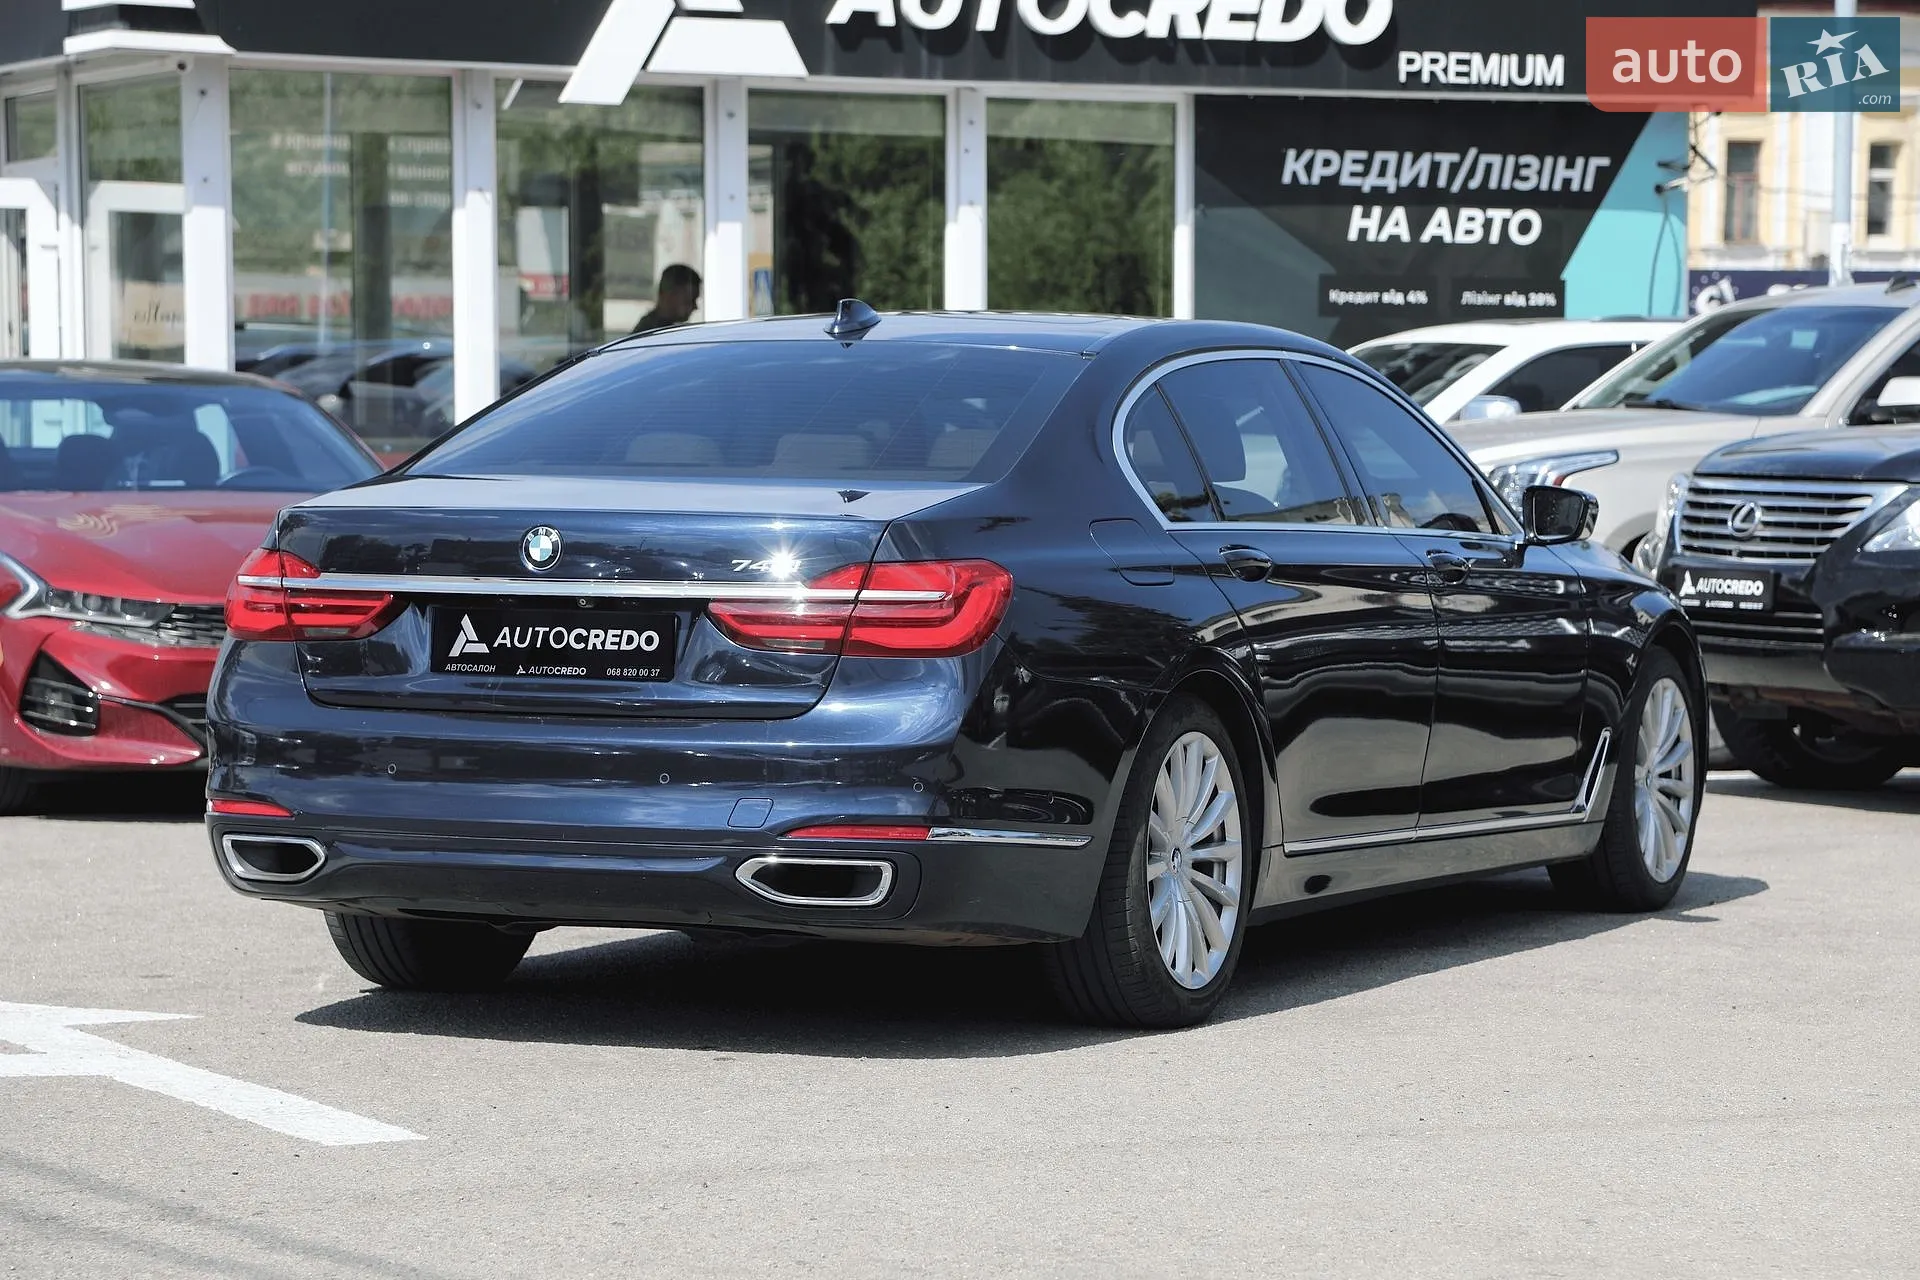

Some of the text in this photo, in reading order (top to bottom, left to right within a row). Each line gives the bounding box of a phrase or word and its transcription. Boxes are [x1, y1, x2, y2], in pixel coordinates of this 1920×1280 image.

[1397, 50, 1566, 87] PREMIUM
[1280, 146, 1612, 194] КРЕДИТ/ЛІЗІНГ
[1347, 204, 1543, 246] НА АВТО
[527, 527, 559, 542] BMW
[1695, 577, 1764, 596] AUTOCREDO
[493, 626, 660, 652] AUTOCREDO
[444, 663, 497, 673] АВТОСАЛОН
[528, 666, 587, 676] AUTOCREDO
[606, 667, 661, 677] 068 820 00 37
